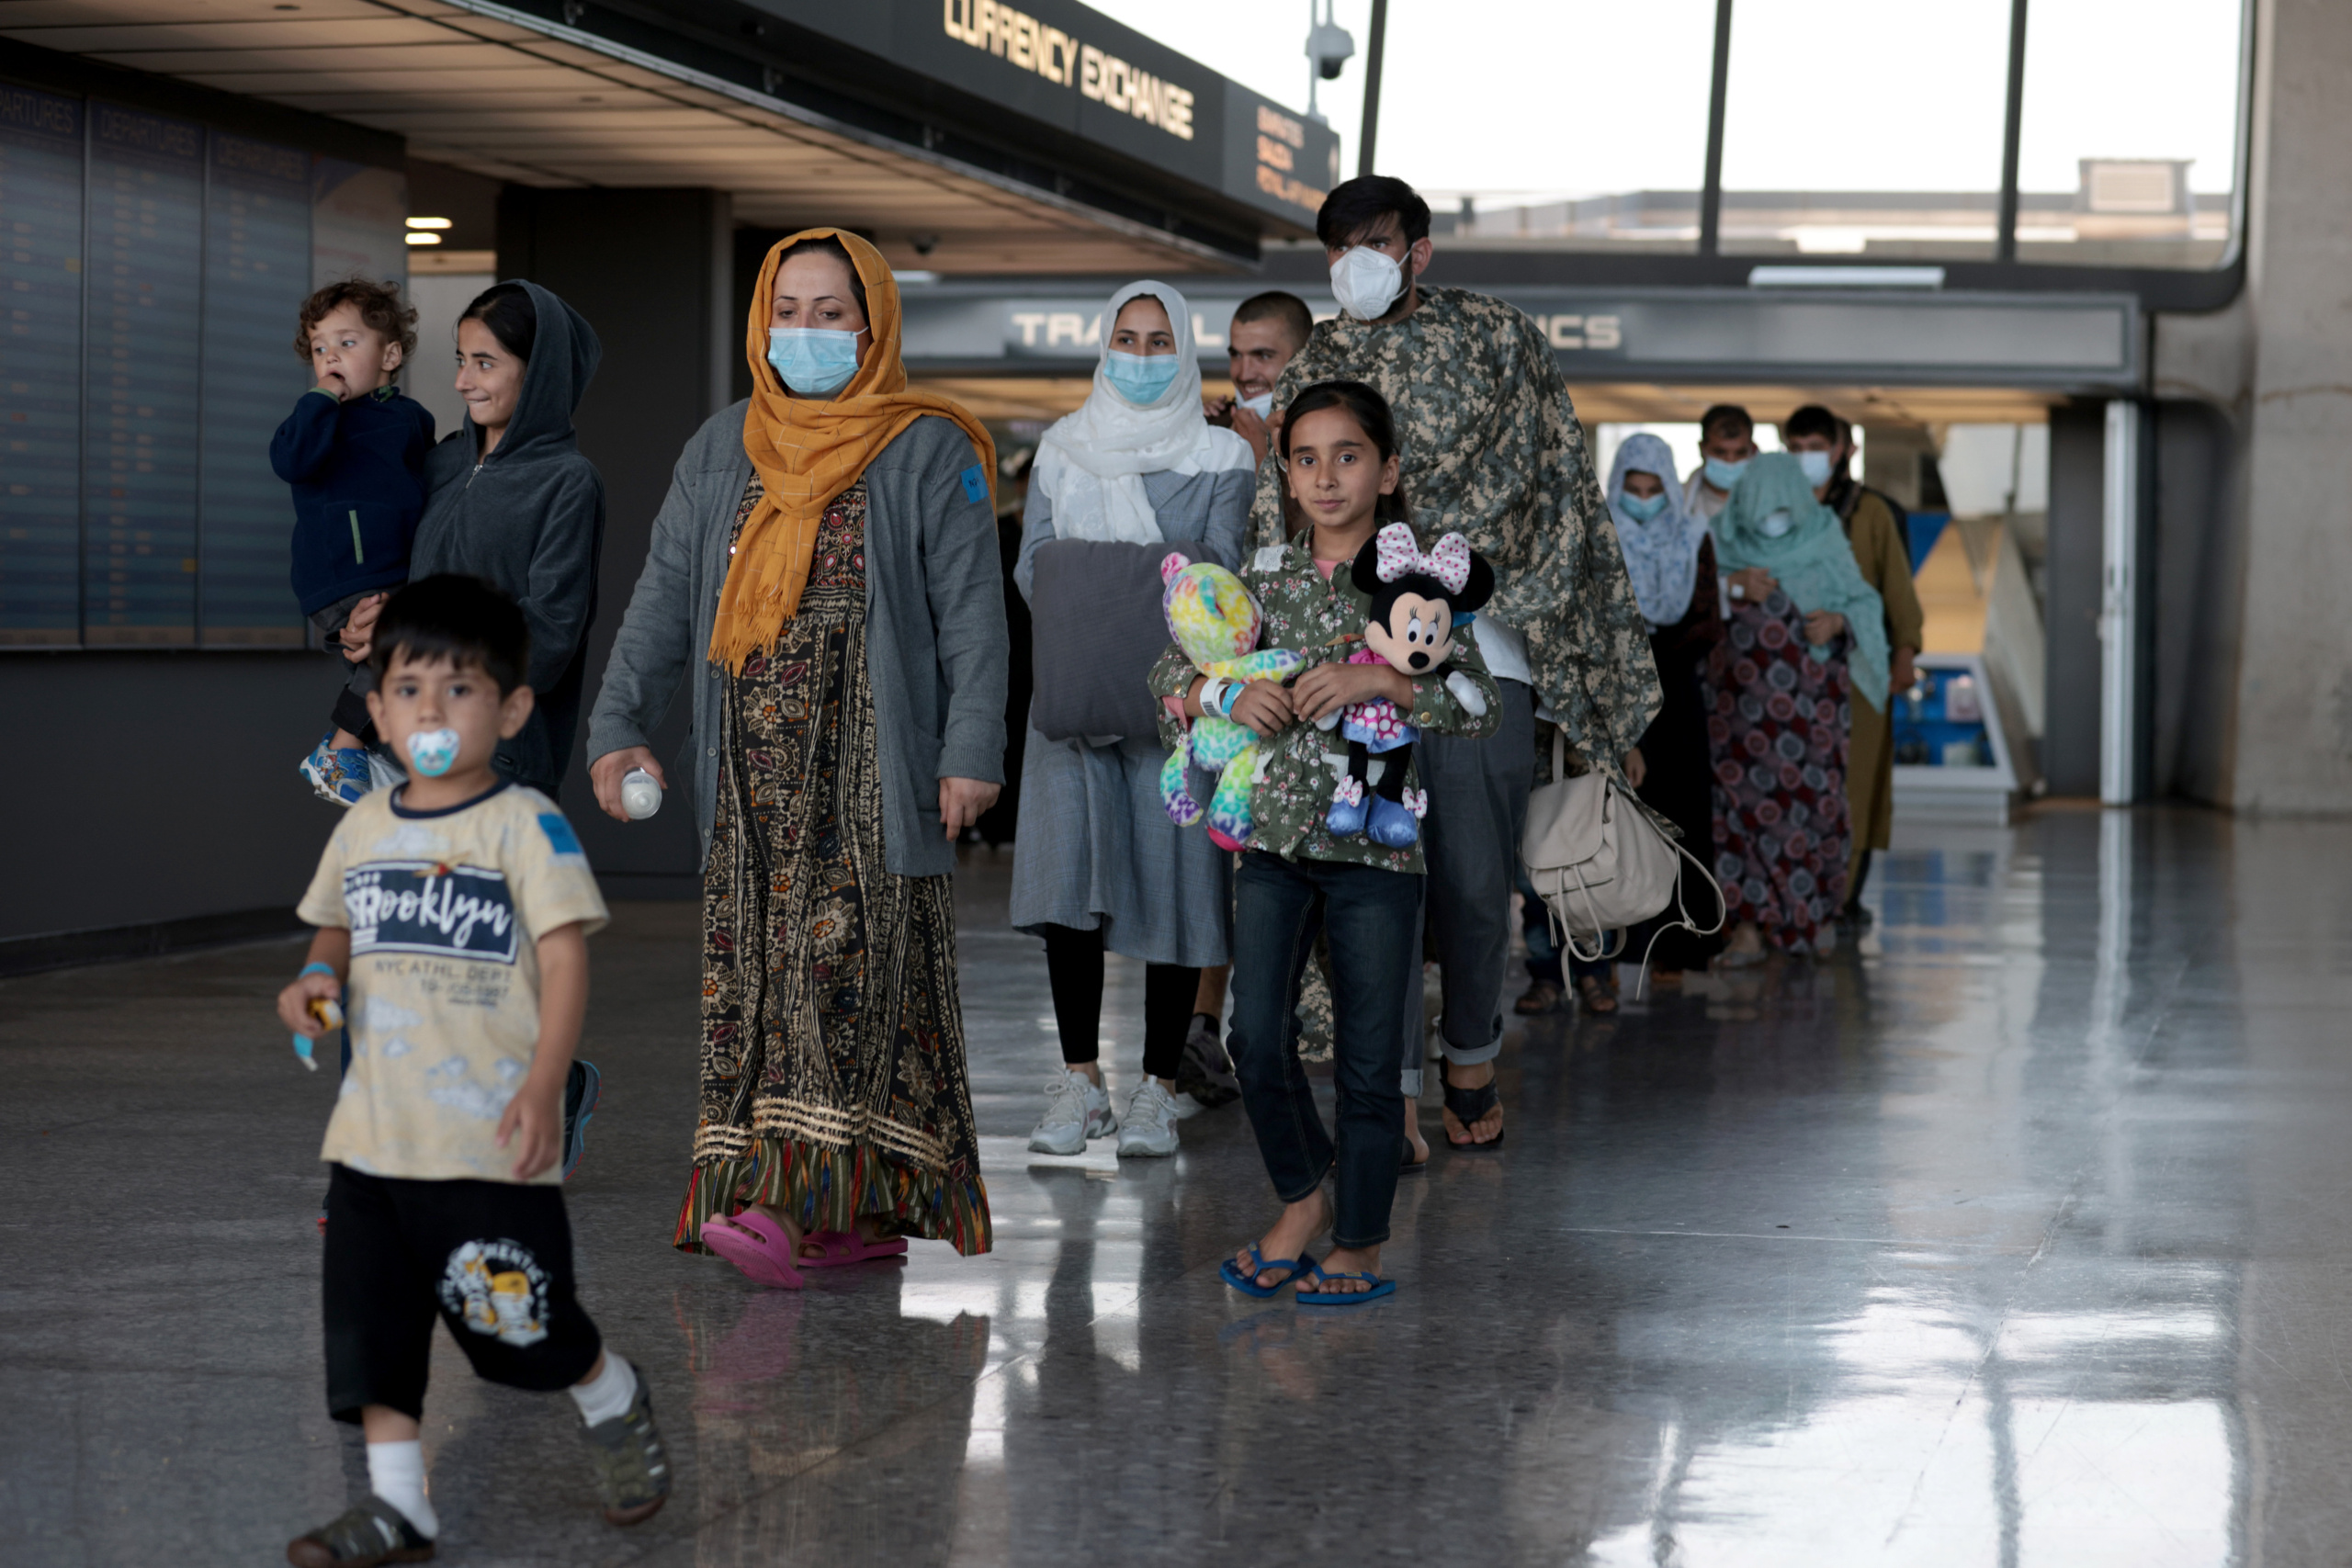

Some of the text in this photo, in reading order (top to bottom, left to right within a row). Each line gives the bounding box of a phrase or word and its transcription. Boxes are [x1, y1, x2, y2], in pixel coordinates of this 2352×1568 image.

[944, 0, 1079, 88] CURRENCY
[1080, 43, 1195, 142] EXCHANGE
[100, 108, 198, 157] DEPARTURES
[375, 958, 404, 976] NYC
